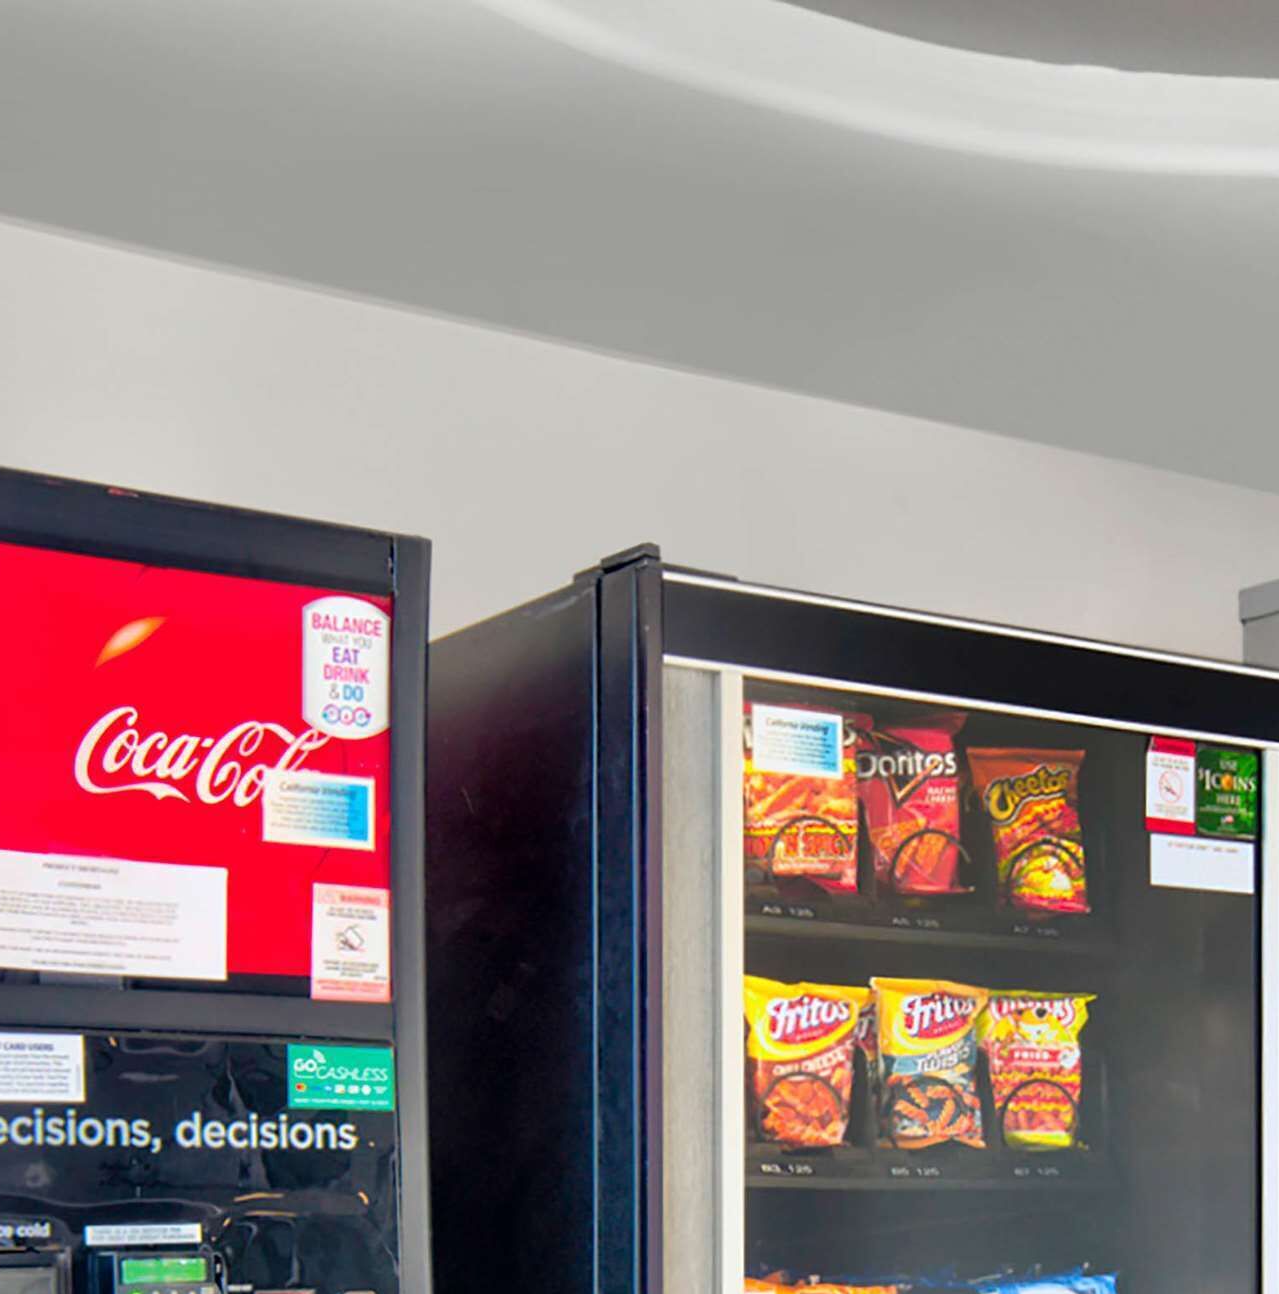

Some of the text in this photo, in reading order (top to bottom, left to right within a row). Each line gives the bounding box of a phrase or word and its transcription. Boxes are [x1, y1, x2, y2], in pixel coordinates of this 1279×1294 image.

[311, 612, 382, 637] BALANCE
[331, 646, 360, 665] EAT
[323, 663, 370, 685] DRINK
[342, 684, 365, 701] DO
[74, 705, 332, 808] Coca-Col
[857, 751, 959, 778] Doritos
[988, 765, 1071, 821] Cheetos
[767, 995, 851, 1040] Fritos
[294, 1058, 318, 1073] GO
[175, 1111, 358, 1151] decisions
[15, 1221, 51, 1239] cold
